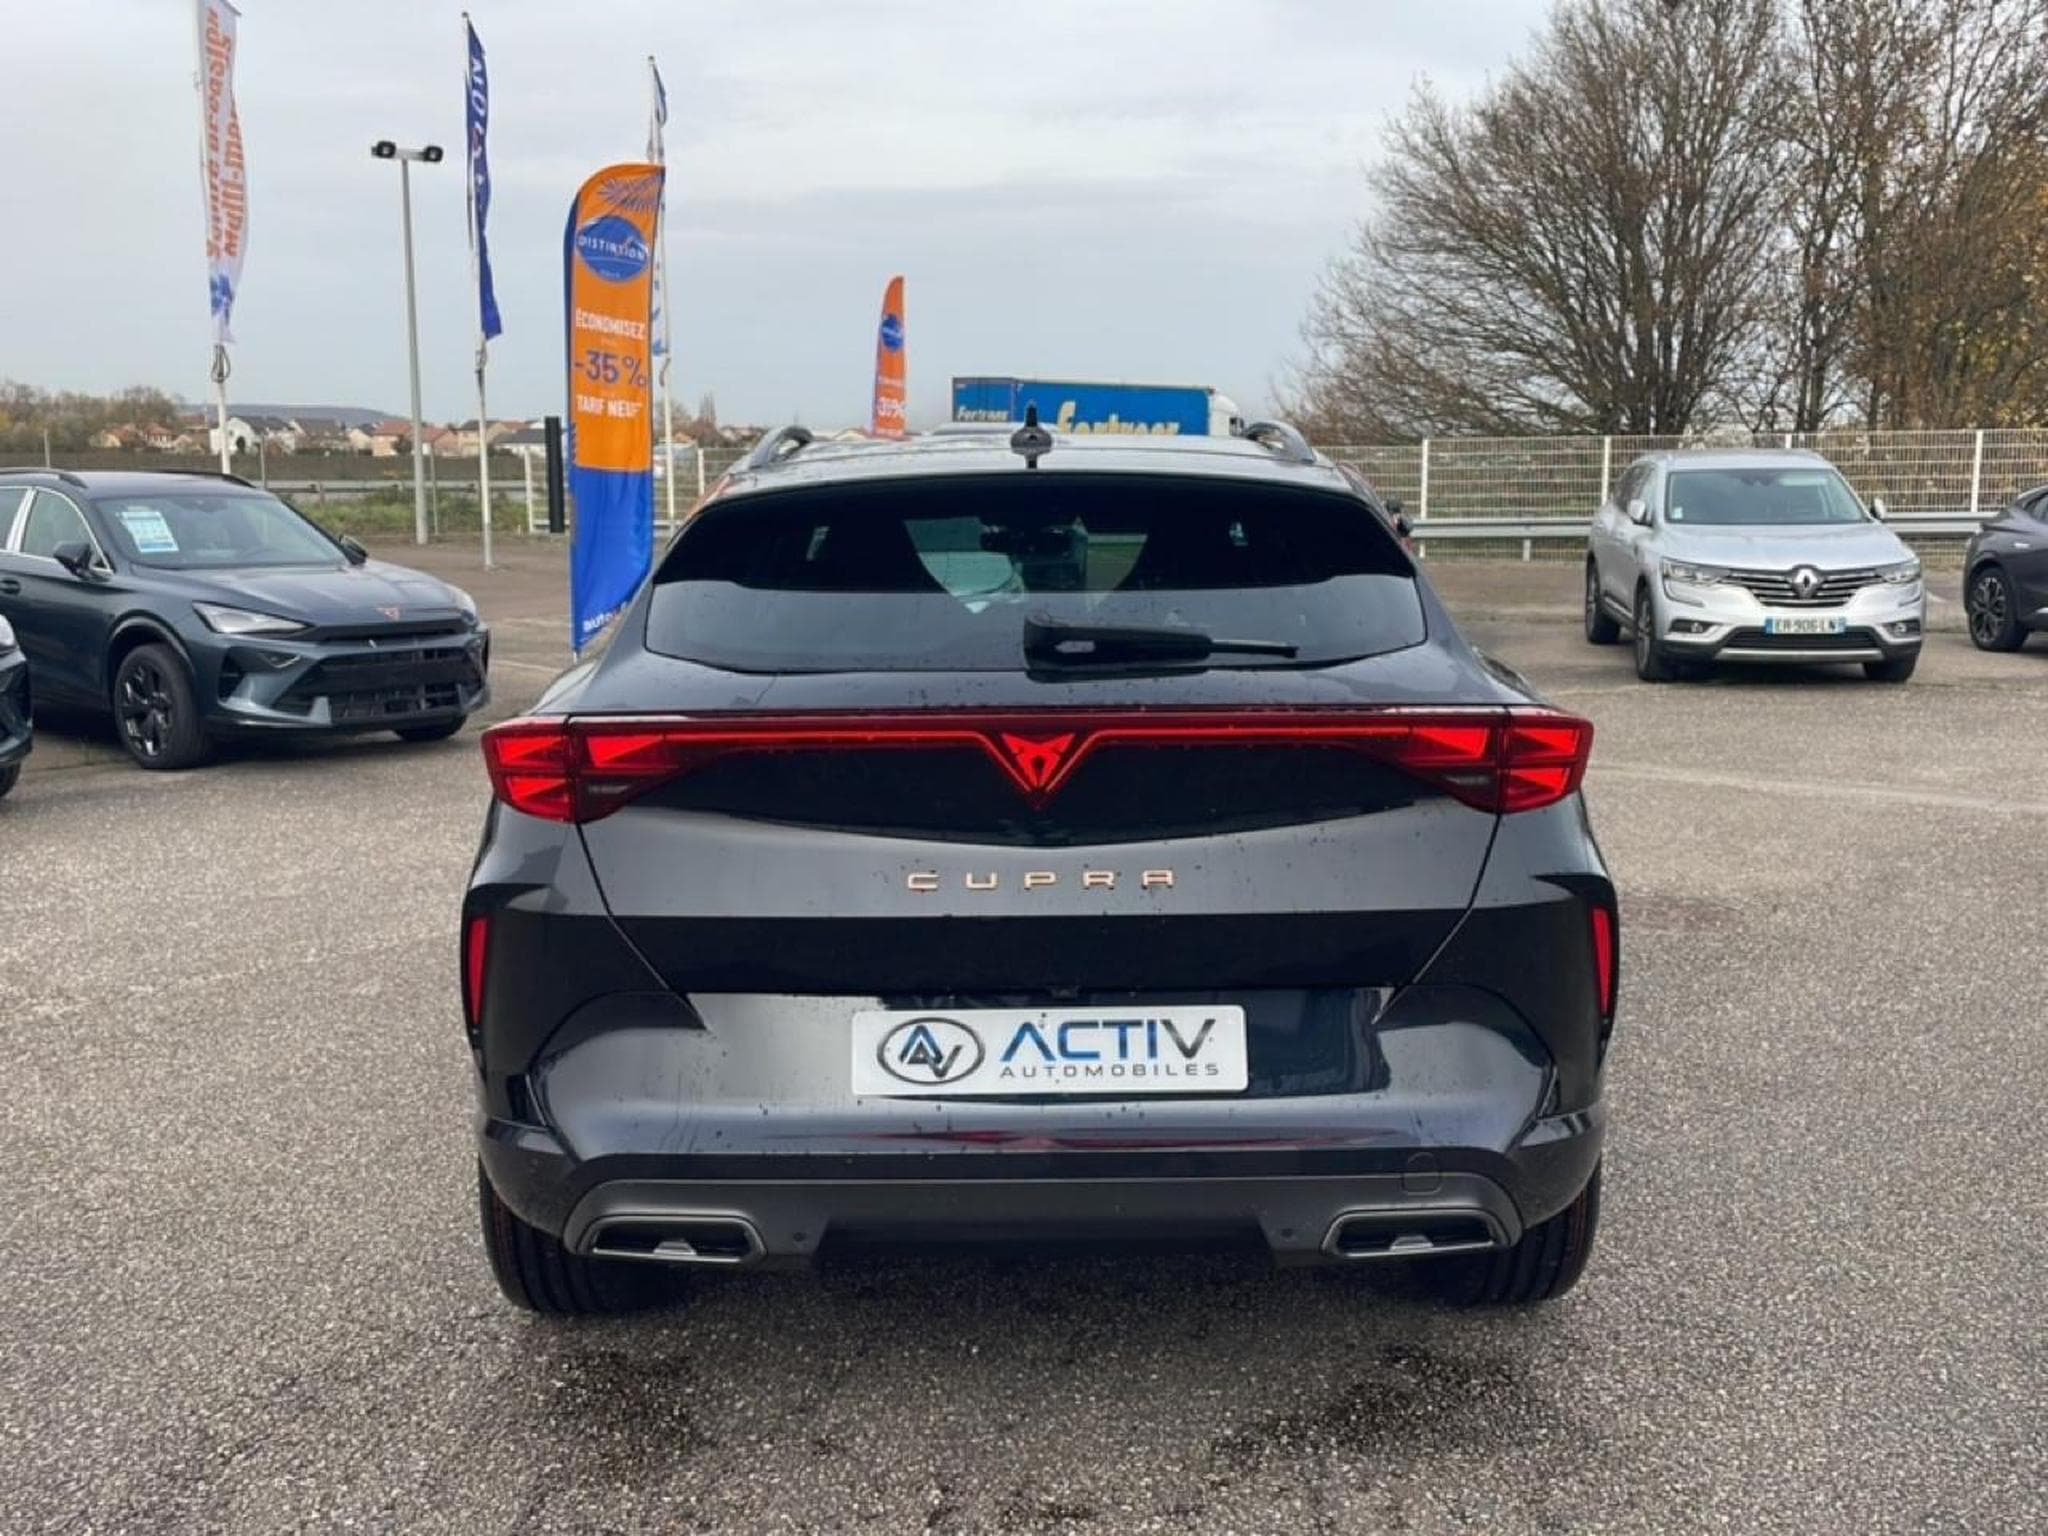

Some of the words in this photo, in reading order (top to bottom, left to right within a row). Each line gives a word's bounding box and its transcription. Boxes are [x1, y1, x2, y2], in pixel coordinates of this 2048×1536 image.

[908, 869, 1174, 892] CUPRA
[1000, 1018, 1216, 1062] ACTIV
[1000, 1063, 1219, 1079] AUTOMOBILES
